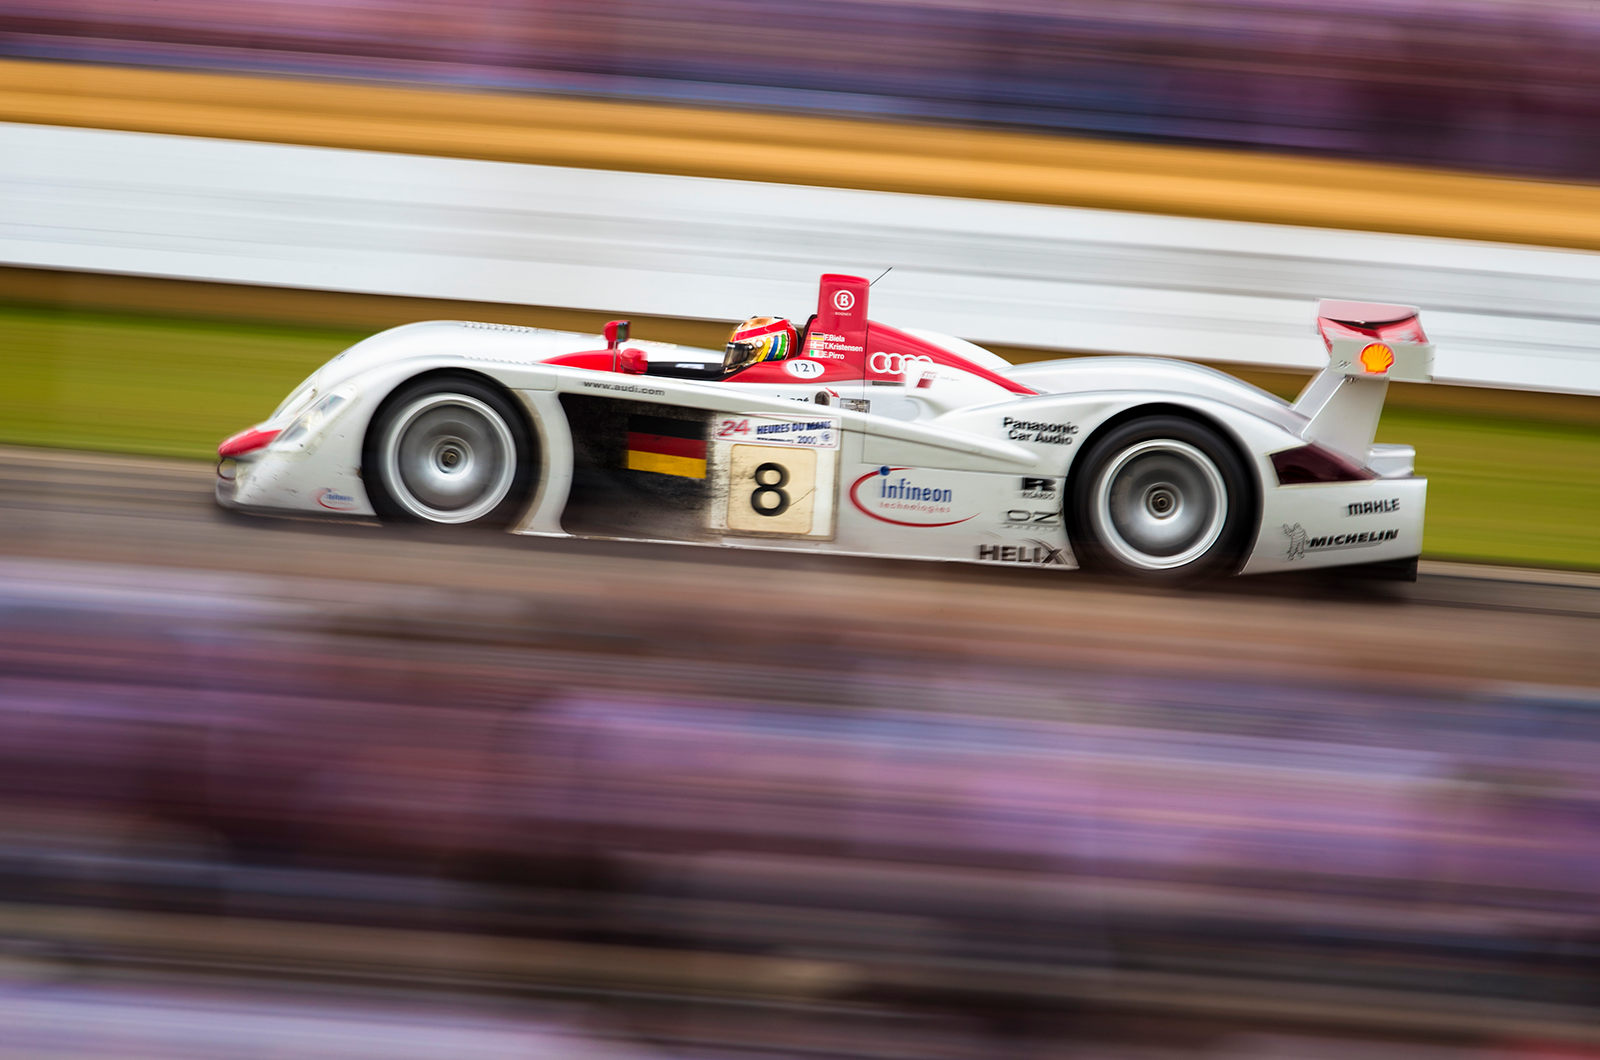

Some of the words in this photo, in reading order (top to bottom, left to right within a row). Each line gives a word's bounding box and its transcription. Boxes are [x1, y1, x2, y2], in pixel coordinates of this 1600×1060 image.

[823, 351, 845, 360] E.Pirro
[824, 343, 863, 352] T.Kristensen
[794, 363, 816, 372] 121
[583, 381, 665, 396] www.audi.com
[719, 419, 751, 437] 24
[757, 424, 790, 435] HEURES
[792, 422, 805, 432] DU
[806, 421, 832, 431] MANS
[1003, 416, 1079, 434] Panasonic
[1008, 429, 1032, 440] Car
[1034, 432, 1073, 445] Audio
[751, 462, 791, 517] 8
[880, 478, 952, 503] Infineon
[878, 500, 951, 513] technologies
[1347, 498, 1400, 516] MAHLE
[1309, 529, 1399, 548] MICHELIN
[978, 543, 1063, 565] HELIX
